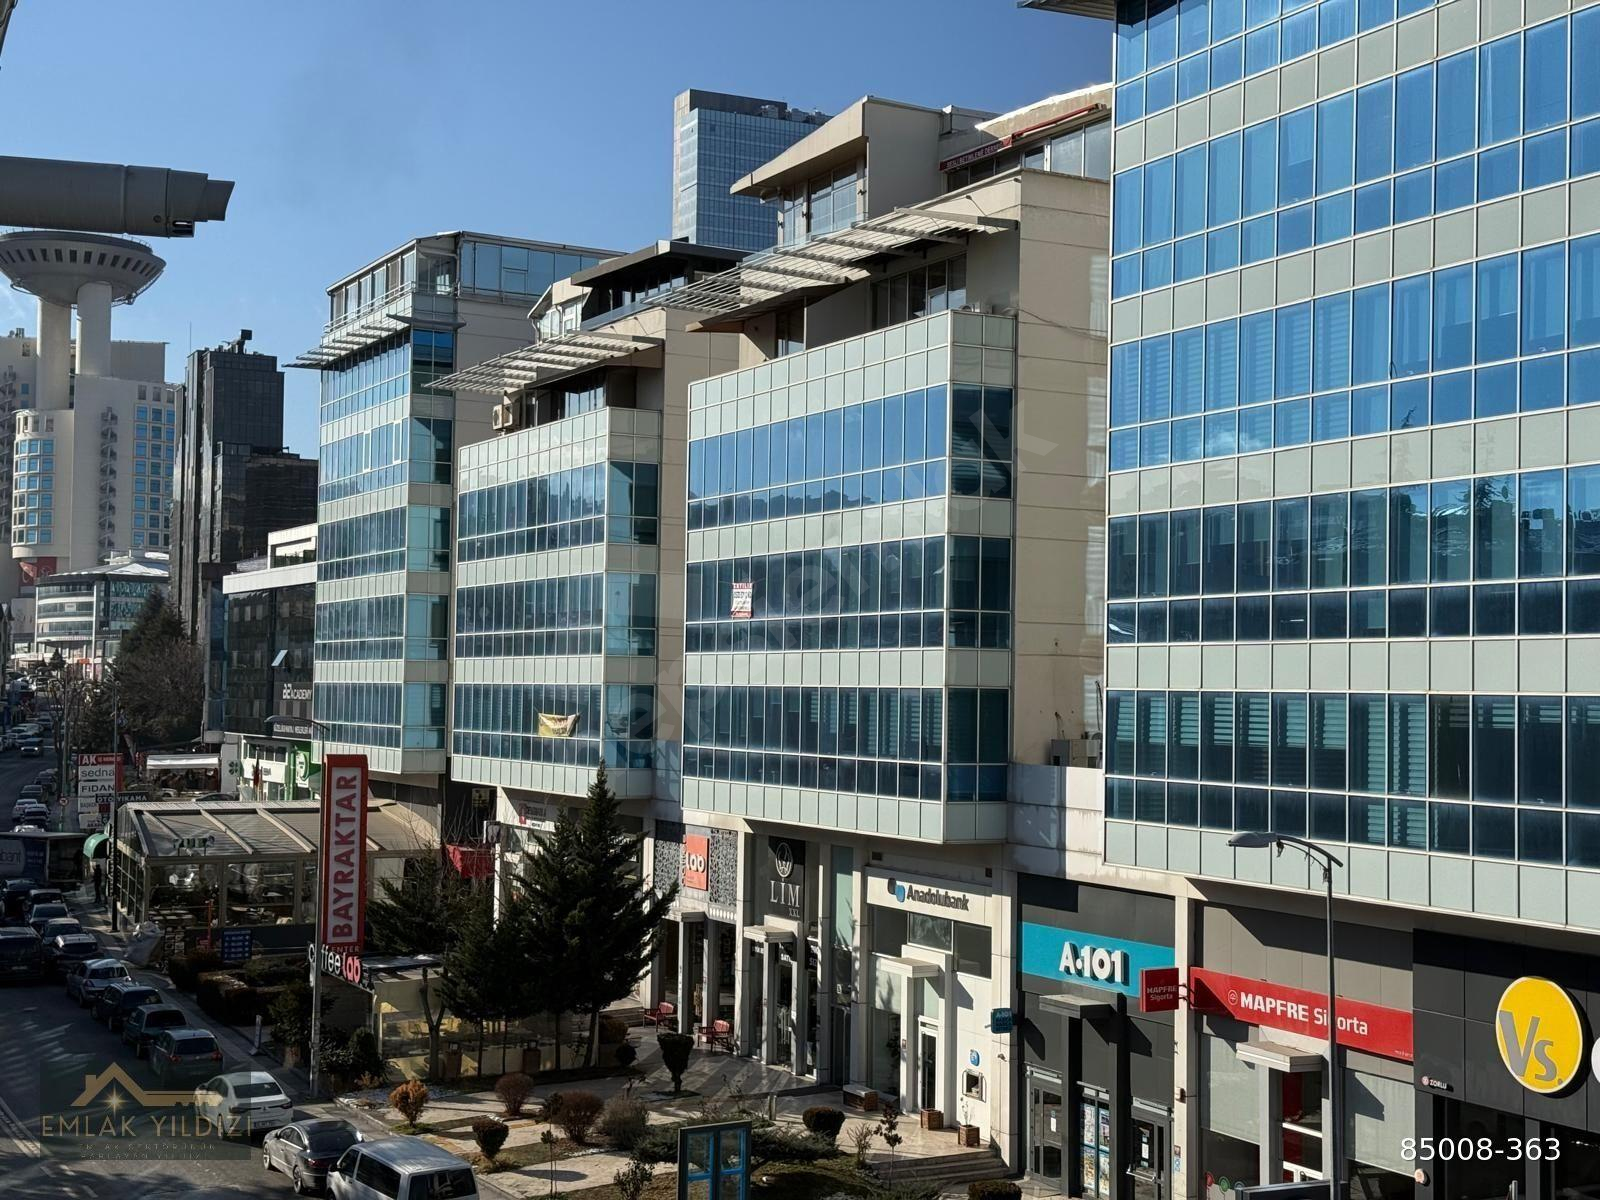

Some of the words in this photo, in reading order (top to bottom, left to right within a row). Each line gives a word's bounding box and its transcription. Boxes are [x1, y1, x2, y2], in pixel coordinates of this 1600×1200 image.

[82, 755, 97, 764] AK
[81, 768, 114, 777] sedna
[333, 774, 357, 938] BAYRAKTAR
[686, 852, 706, 873] lab
[906, 883, 970, 912] Anadolubank
[342, 952, 361, 984] lab
[1147, 985, 1177, 994] MAPFRE
[1150, 993, 1173, 1003] Sigorta
[1240, 991, 1309, 1022] MAPFRE
[1314, 1006, 1368, 1036] Siorta
